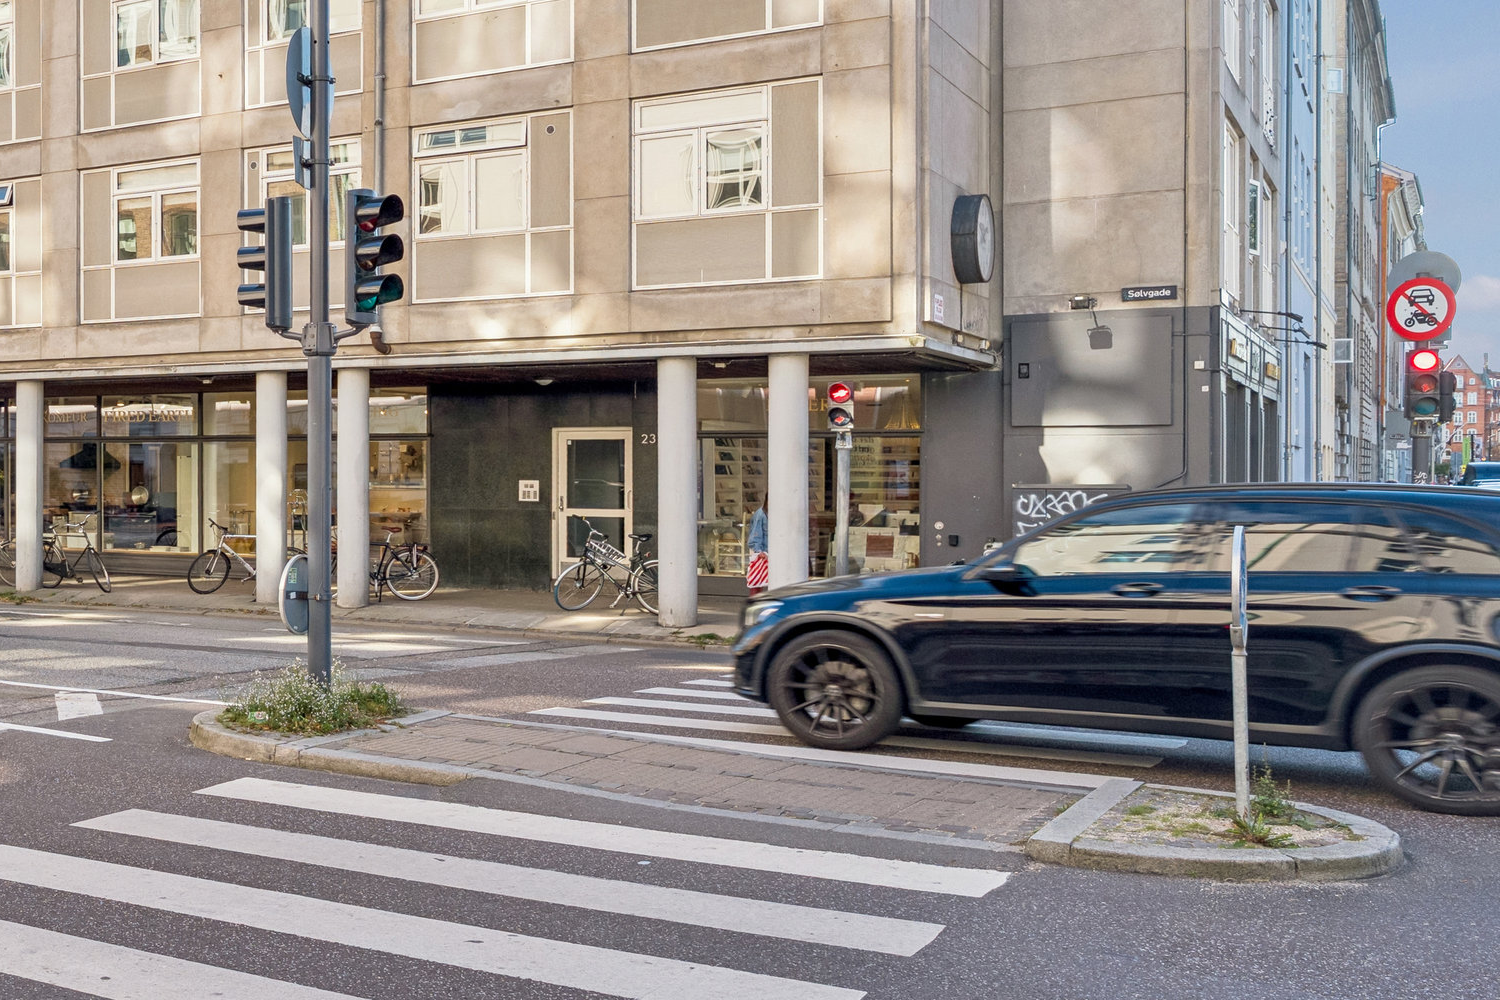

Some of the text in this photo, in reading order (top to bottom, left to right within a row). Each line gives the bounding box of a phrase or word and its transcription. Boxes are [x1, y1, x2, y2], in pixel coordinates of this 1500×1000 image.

[1128, 289, 1171, 298] Sølvgade
[103, 409, 195, 423] FIRED EARTH
[641, 434, 656, 443] 23
